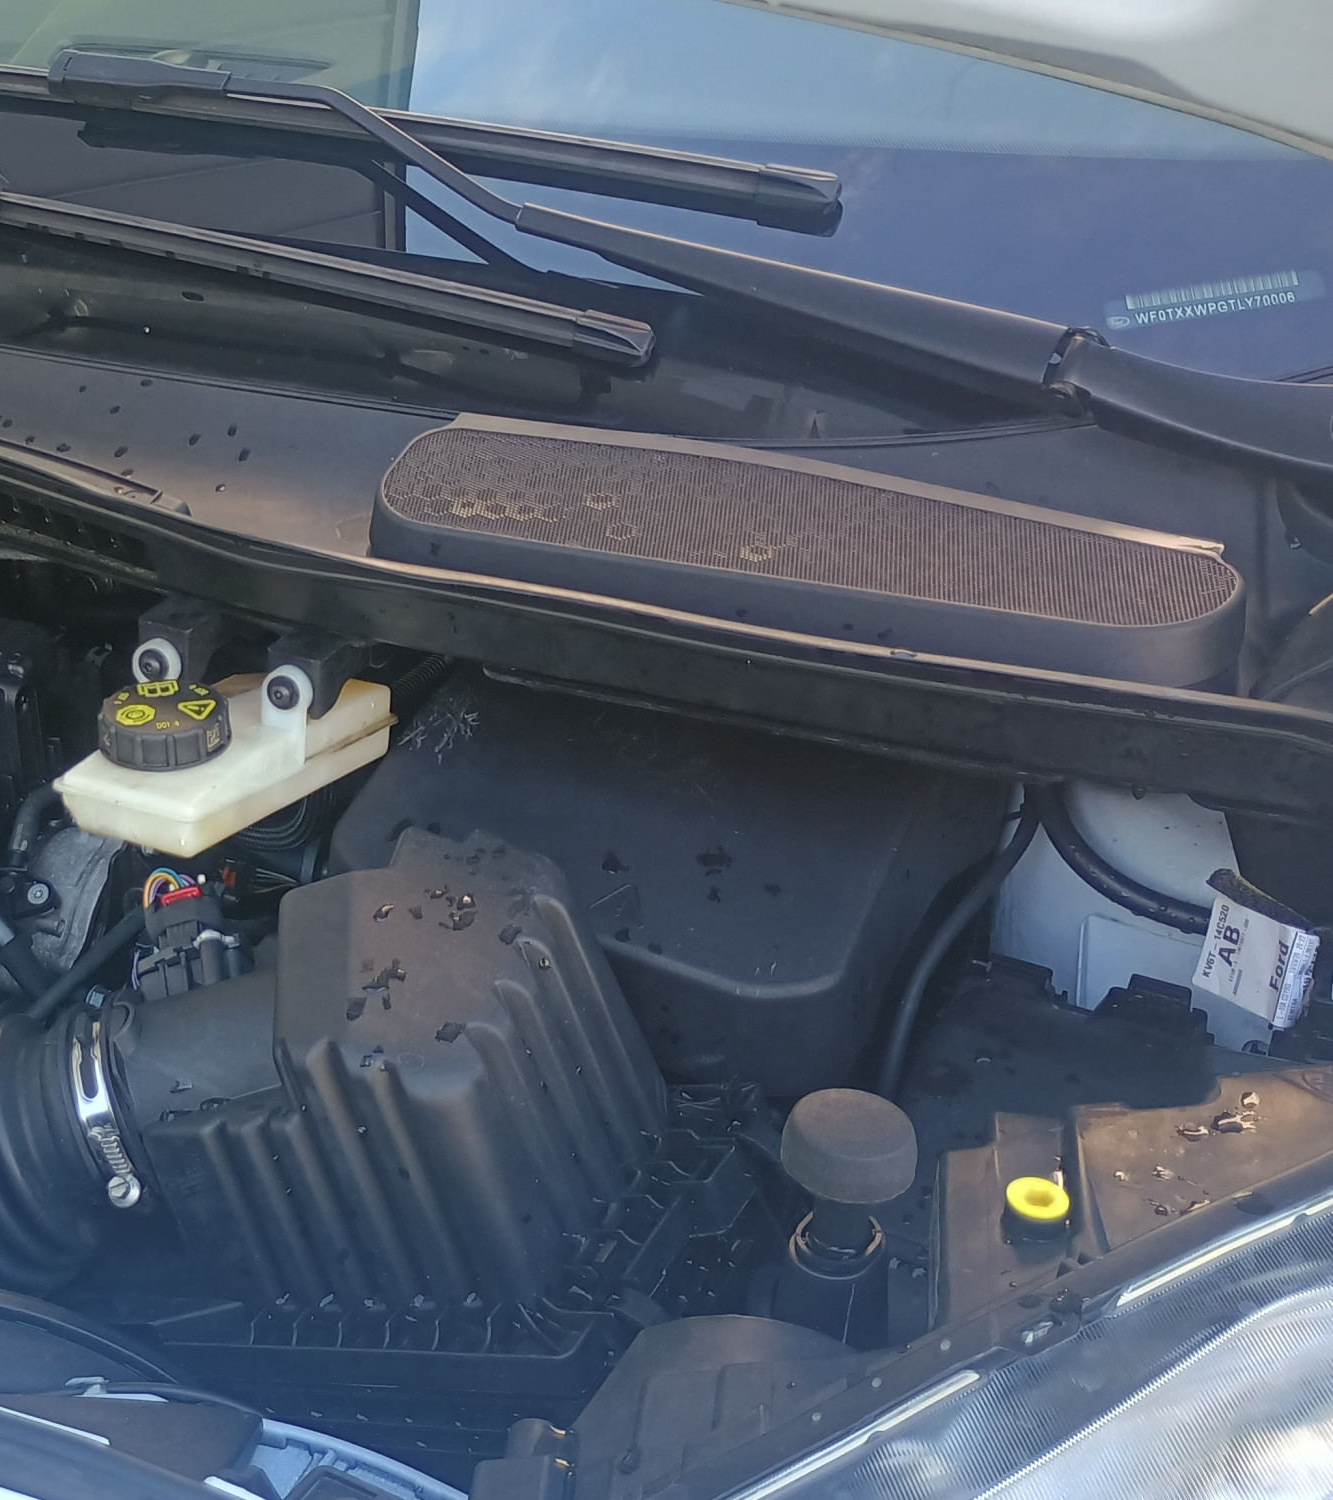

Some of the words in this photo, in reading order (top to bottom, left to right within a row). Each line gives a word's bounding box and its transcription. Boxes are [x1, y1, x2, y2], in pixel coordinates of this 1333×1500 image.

[1214, 904, 1230, 941] 14C520
[1218, 925, 1240, 967] AB
[1269, 940, 1289, 992] Ford
